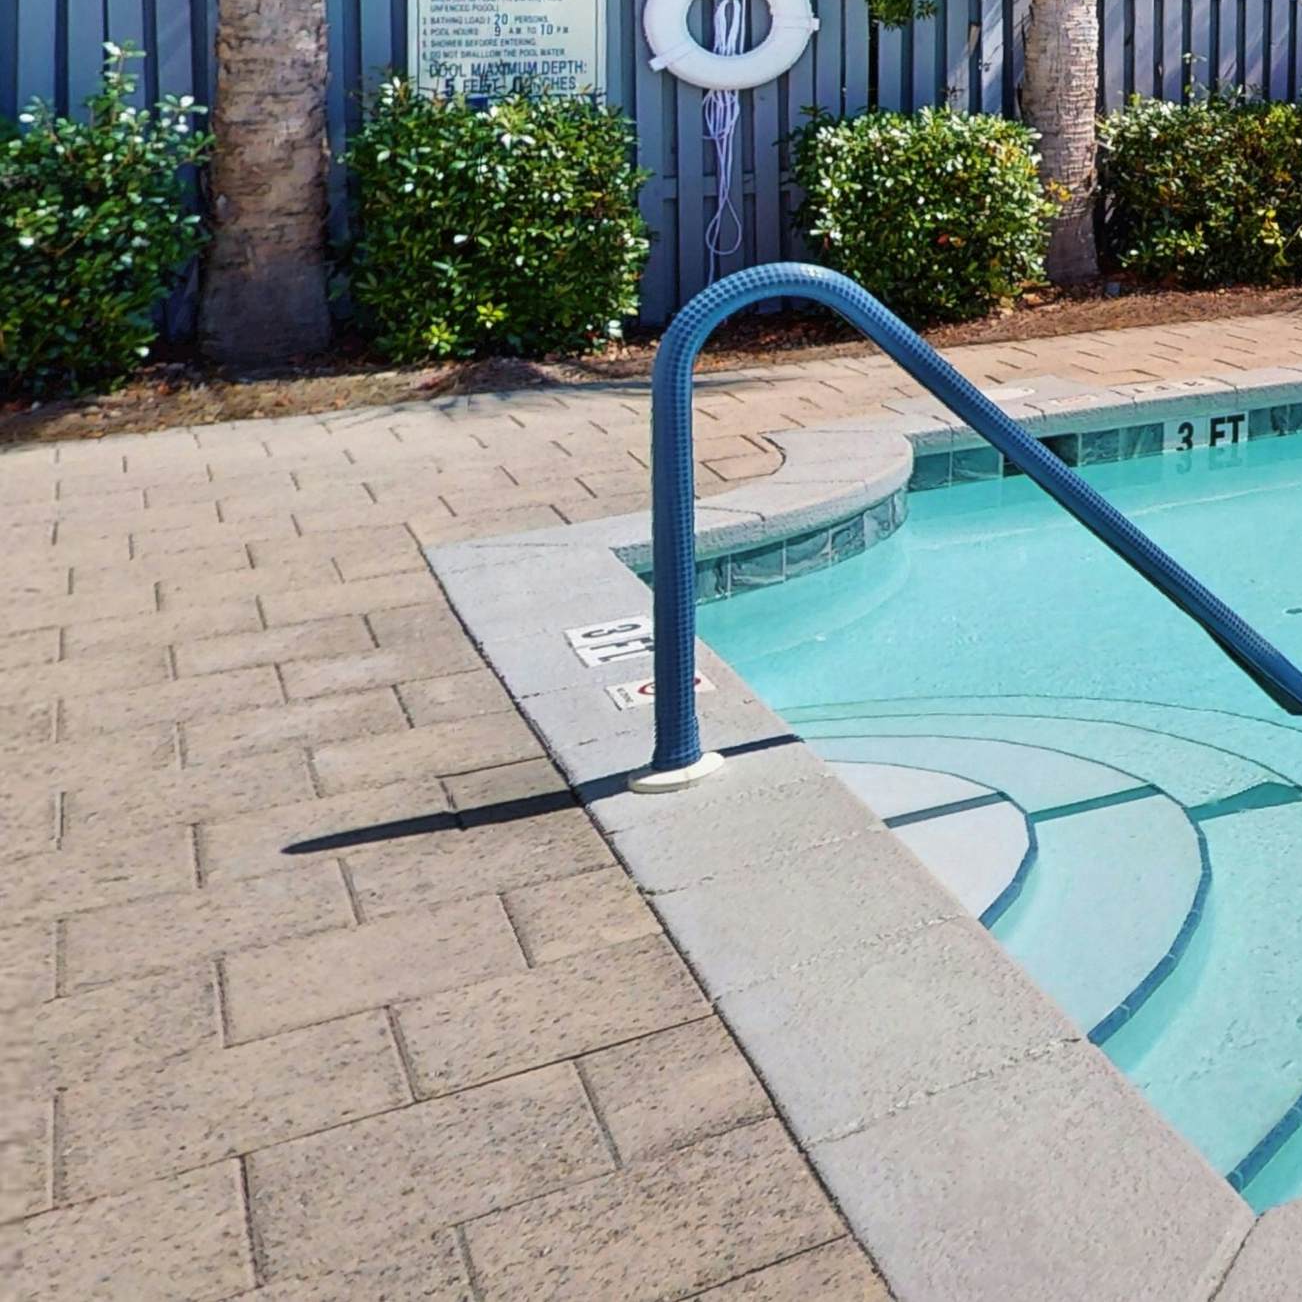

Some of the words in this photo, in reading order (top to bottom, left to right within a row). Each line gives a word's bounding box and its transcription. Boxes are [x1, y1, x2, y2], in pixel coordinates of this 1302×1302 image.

[494, 14, 509, 26] 20
[495, 26, 502, 37] 9
[540, 24, 554, 36] 10
[1176, 421, 1194, 451] 3
[1209, 414, 1245, 446] FT
[581, 624, 642, 638] 3
